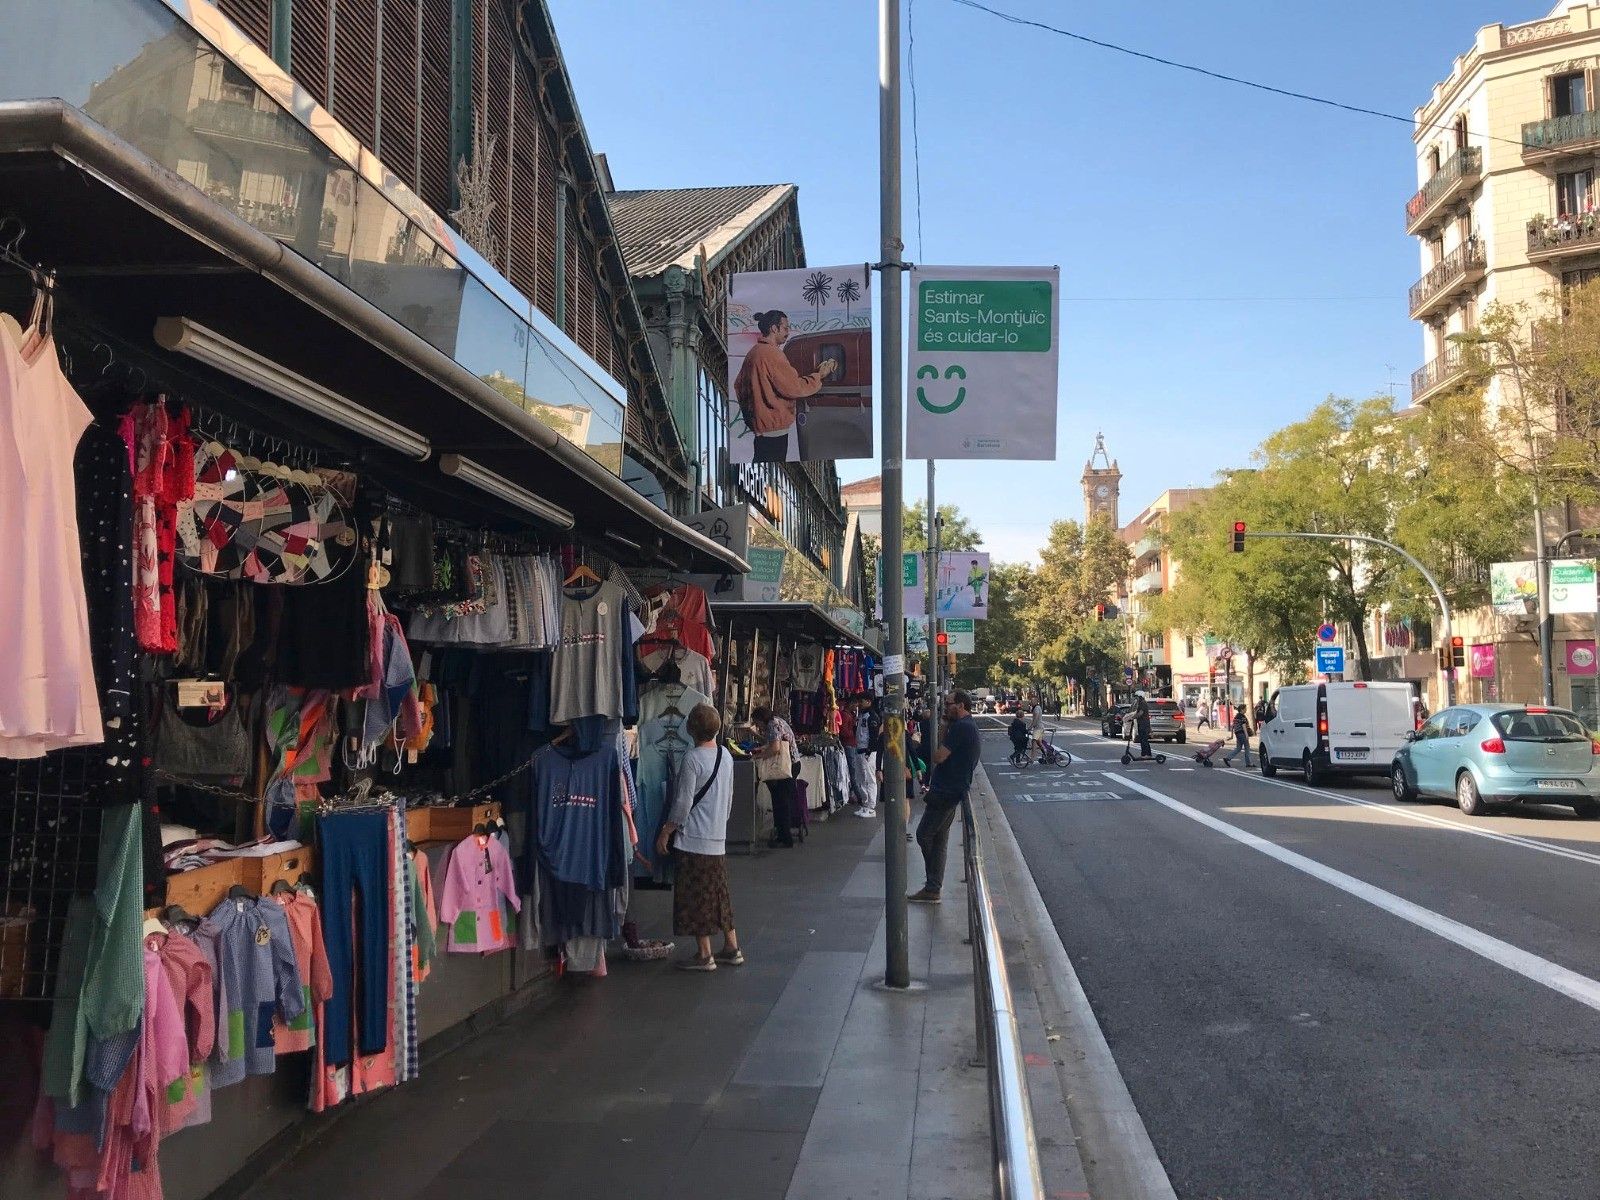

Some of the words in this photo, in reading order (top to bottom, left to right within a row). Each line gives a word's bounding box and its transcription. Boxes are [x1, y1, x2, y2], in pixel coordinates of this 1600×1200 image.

[925, 289, 985, 305] Estimar
[924, 308, 1046, 328] Sants-Montjuïc
[924, 328, 943, 343] és
[947, 328, 1019, 344] cuidar-lo
